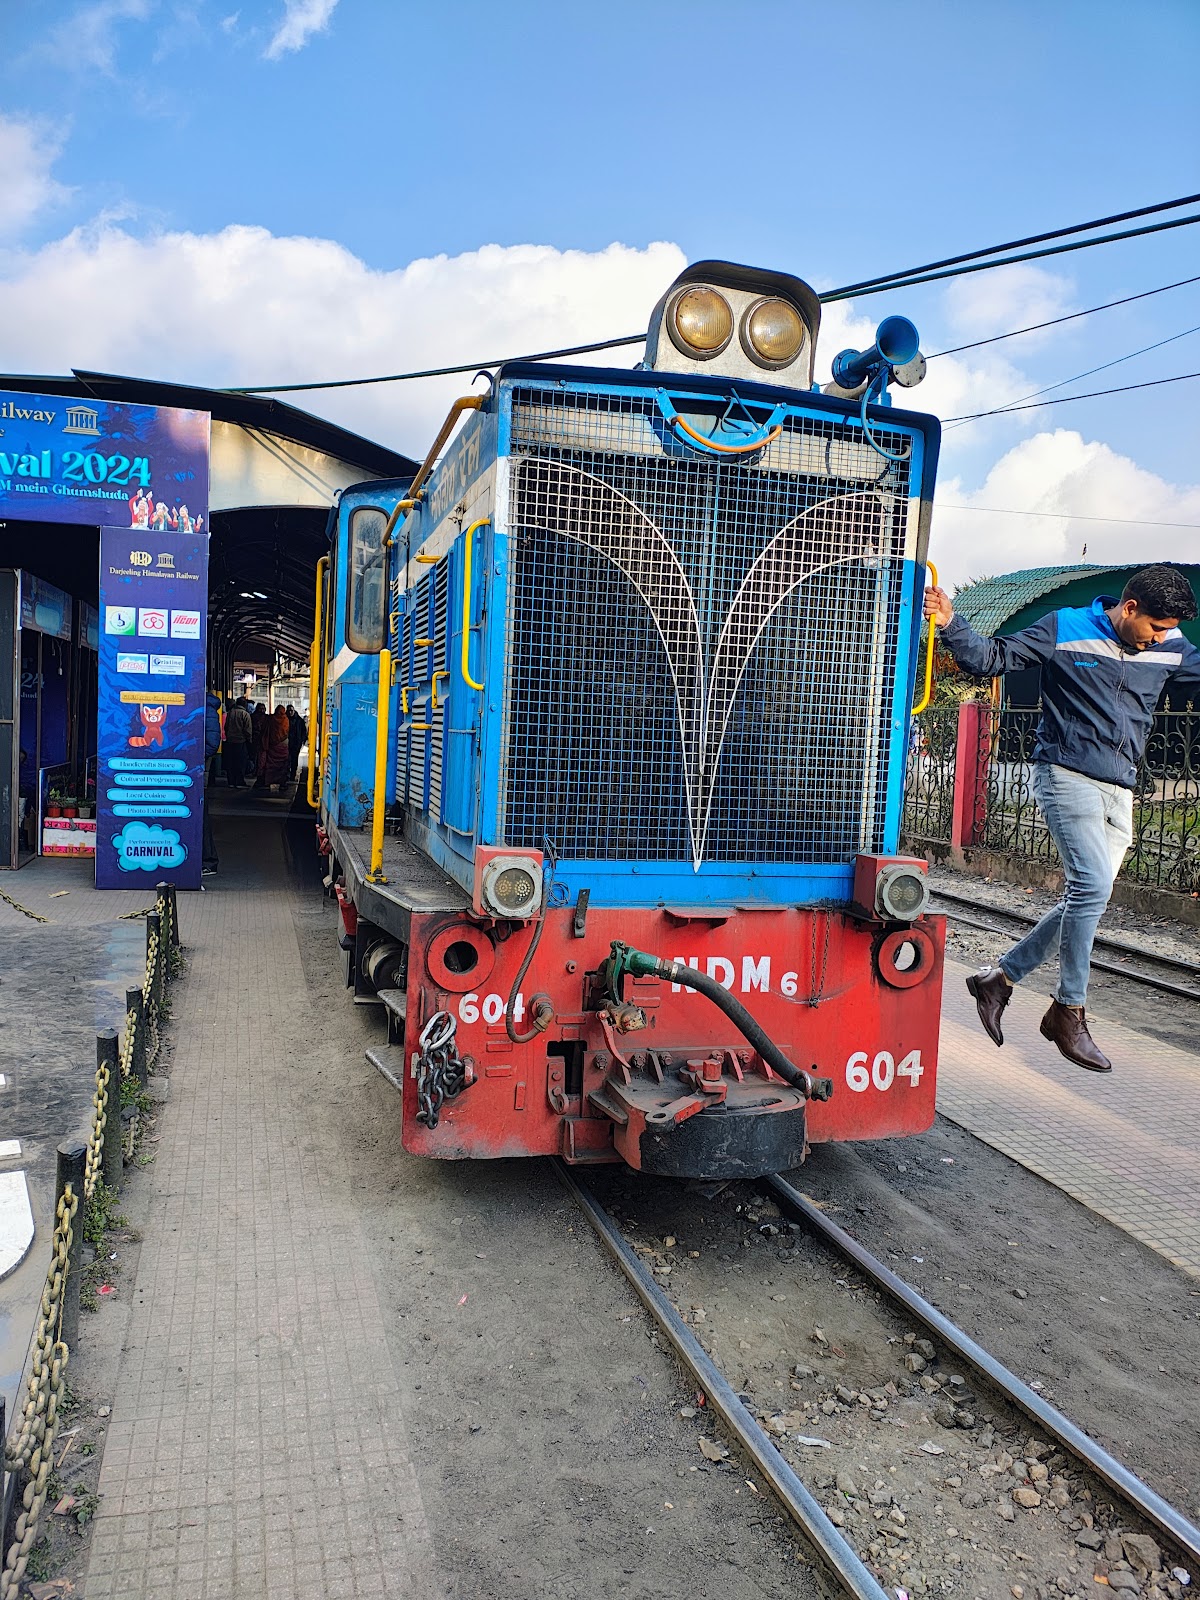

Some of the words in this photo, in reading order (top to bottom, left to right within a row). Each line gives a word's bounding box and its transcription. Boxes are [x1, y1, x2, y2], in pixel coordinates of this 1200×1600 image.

[0, 402, 56, 425] ilway
[61, 451, 151, 487] 2024
[15, 482, 49, 494] mein
[52, 484, 129, 501] Ghumshuda
[109, 566, 141, 577] Darjeeling
[142, 569, 175, 579] Himalayan
[176, 571, 200, 581] Railway
[126, 846, 175, 857] CARNIVAL
[458, 992, 526, 1024] 604
[845, 1049, 925, 1093] 604
